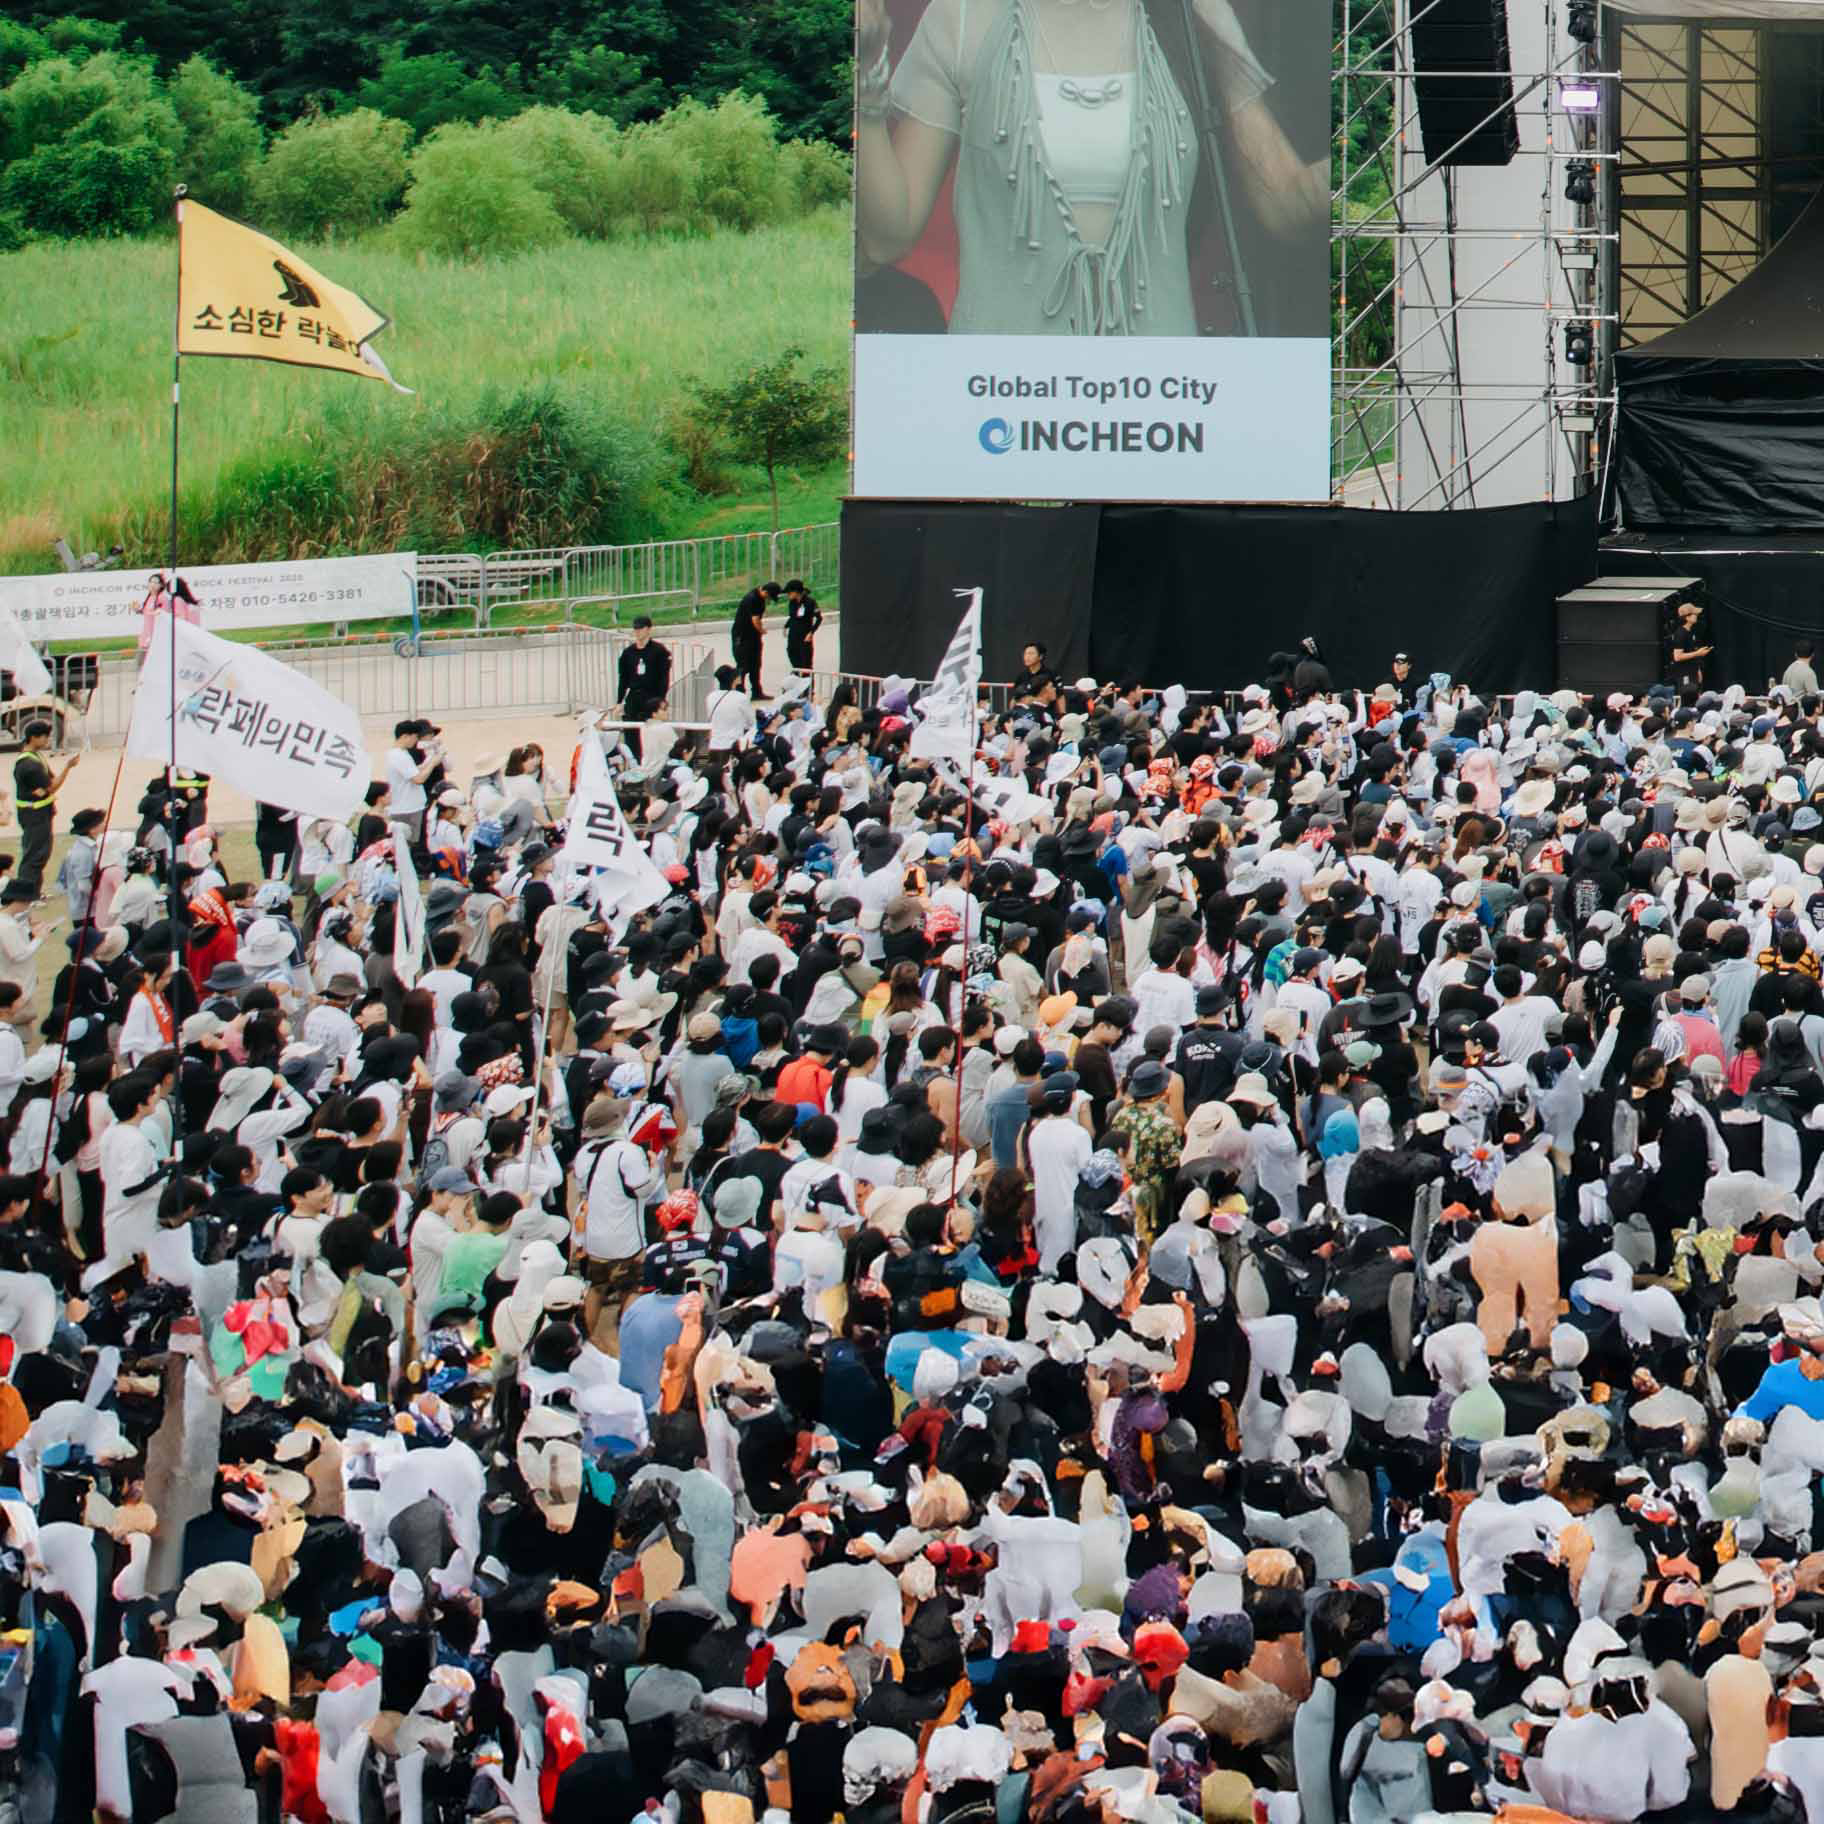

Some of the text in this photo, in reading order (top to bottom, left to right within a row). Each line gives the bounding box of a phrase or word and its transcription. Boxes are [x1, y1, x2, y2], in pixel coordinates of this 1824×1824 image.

[193, 304, 287, 339] 소심한
[967, 375, 1217, 405] Global Top10 City
[1020, 420, 1204, 453] INCHEON
[198, 686, 357, 779] 락페의민족
